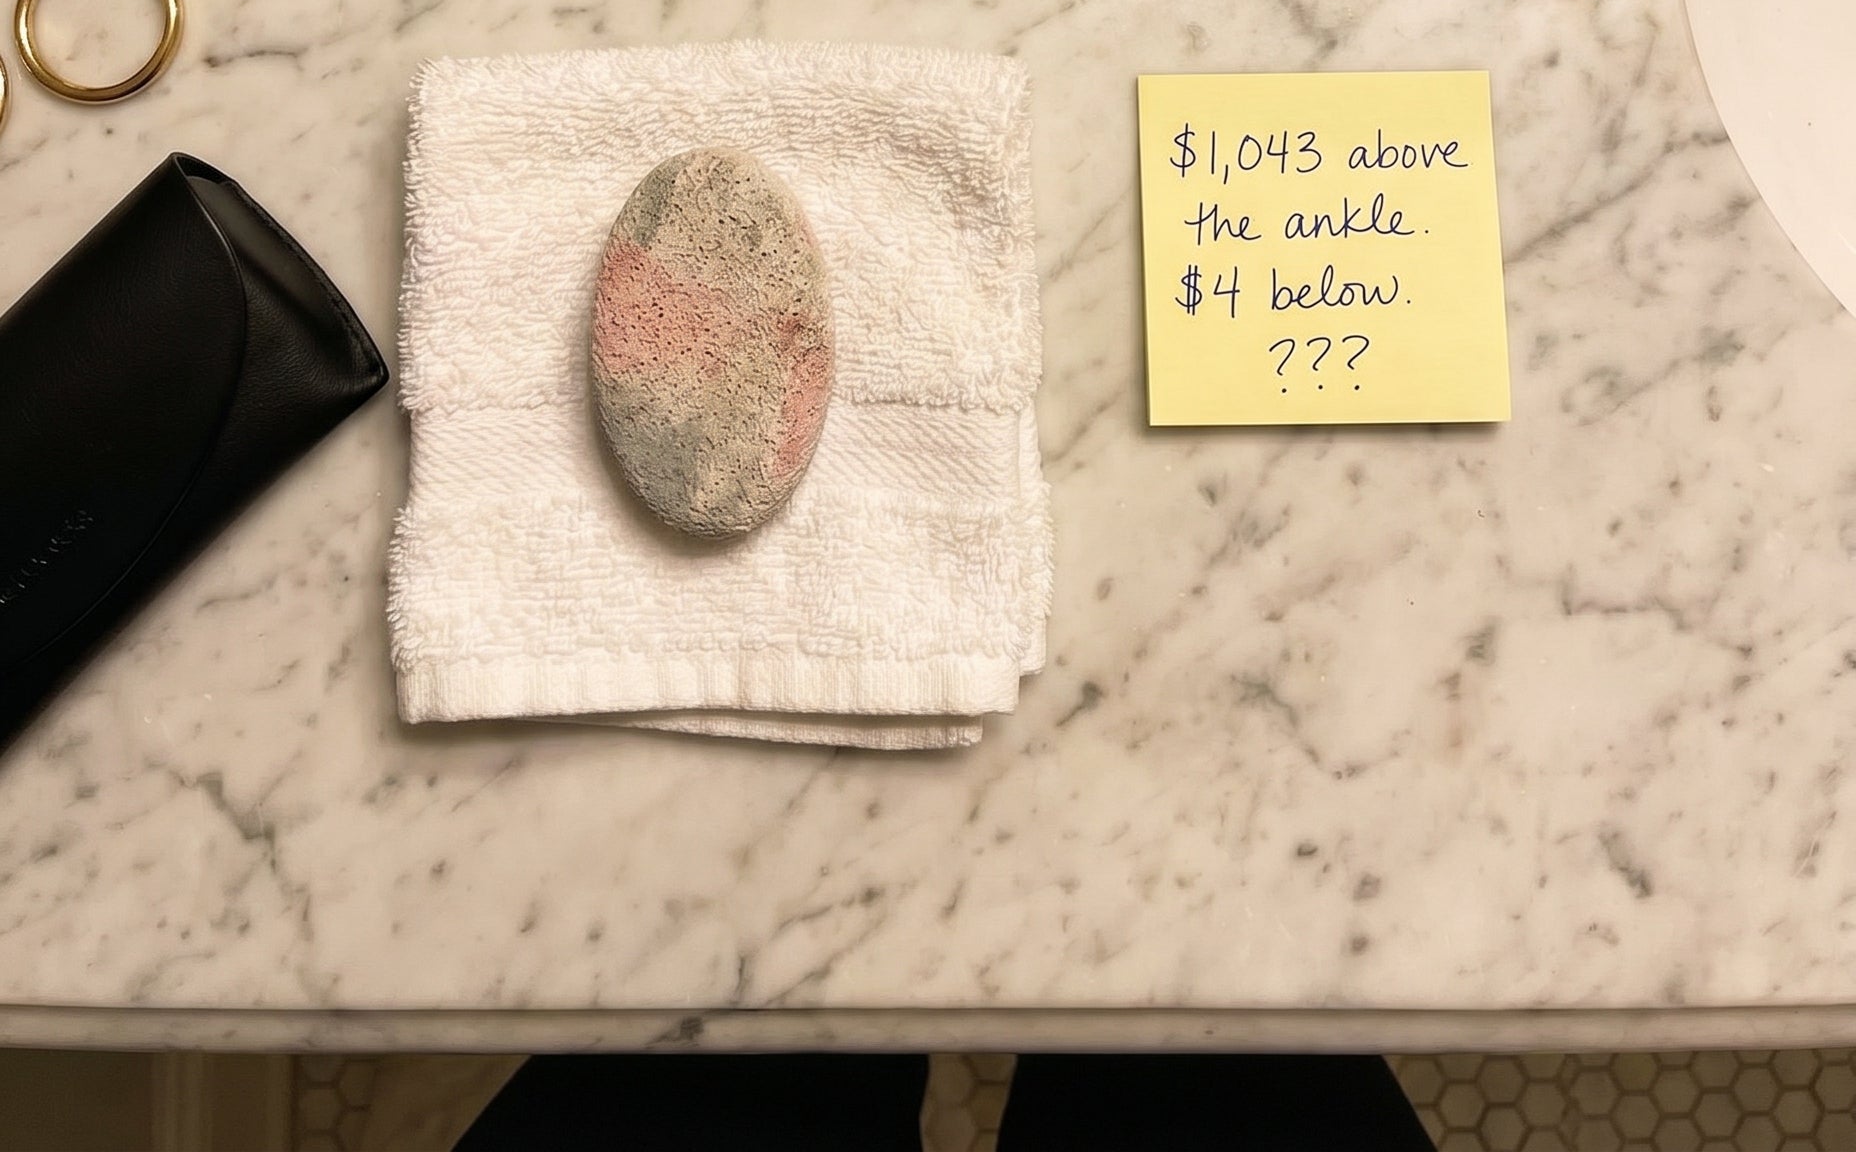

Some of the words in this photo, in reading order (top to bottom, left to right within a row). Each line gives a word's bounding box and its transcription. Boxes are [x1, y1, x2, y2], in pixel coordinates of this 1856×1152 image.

[1170, 123, 1322, 185] $1,043
[1349, 129, 1469, 169] above
[1185, 202, 1261, 246] the
[1285, 193, 1430, 239] ankle.
[1175, 264, 1241, 318] $4
[1272, 264, 1412, 310] below.
